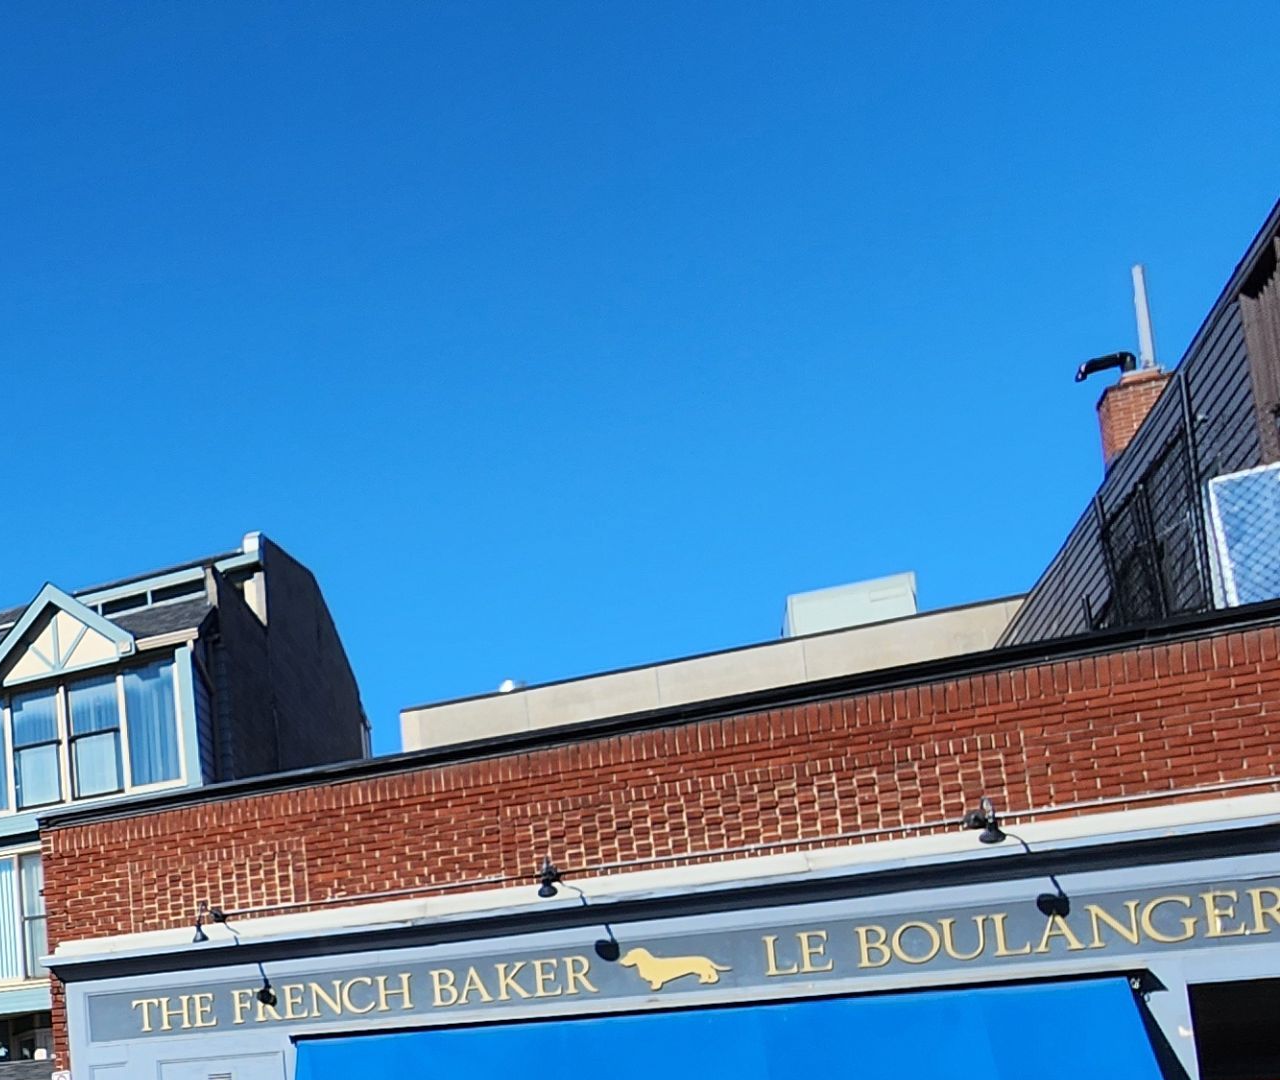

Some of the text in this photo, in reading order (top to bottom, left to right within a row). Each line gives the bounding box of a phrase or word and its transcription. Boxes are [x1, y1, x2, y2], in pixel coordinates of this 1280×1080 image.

[761, 885, 1280, 977] LE BOULANGER
[133, 993, 217, 1033] THE
[430, 954, 599, 1008] BAKER
